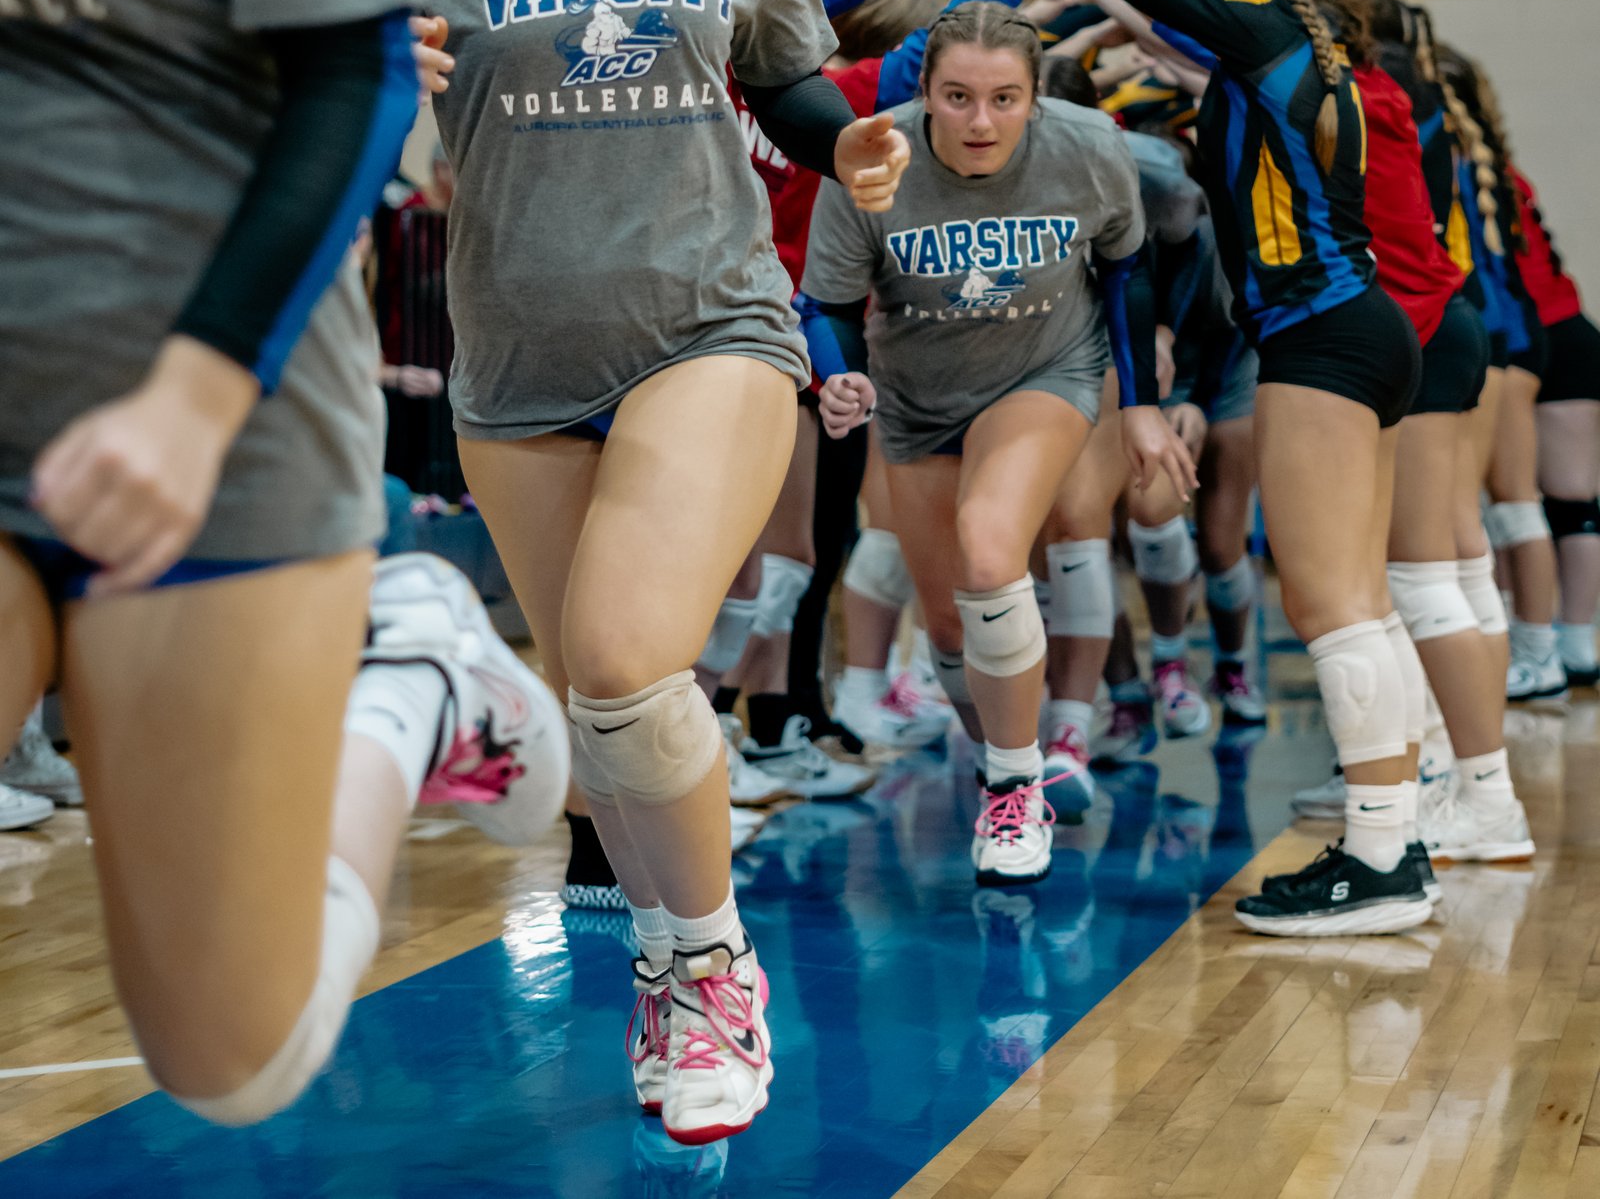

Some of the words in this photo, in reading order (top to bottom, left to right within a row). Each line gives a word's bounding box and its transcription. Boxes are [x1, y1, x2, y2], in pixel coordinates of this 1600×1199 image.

[561, 49, 656, 87] ACC
[513, 119, 578, 134] AURORA
[581, 115, 655, 132] CENTRAL
[887, 215, 1079, 278] VARSITY
